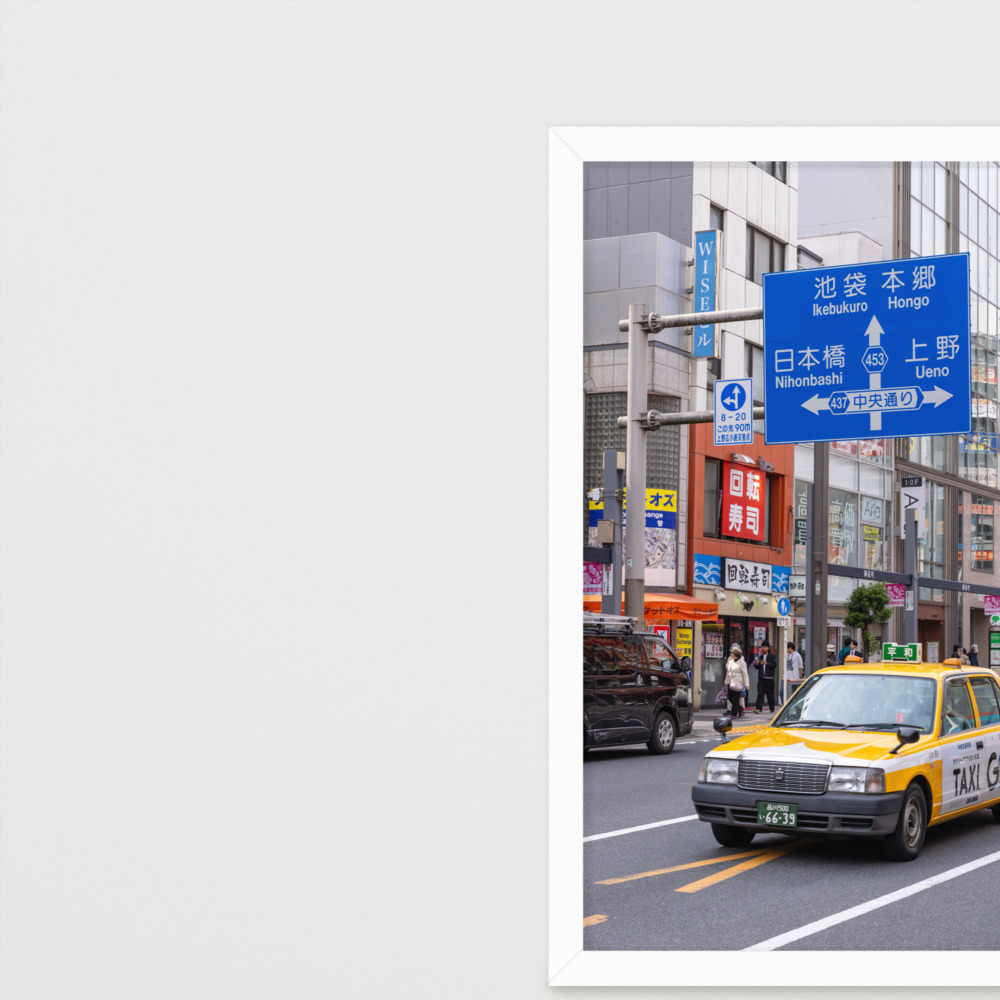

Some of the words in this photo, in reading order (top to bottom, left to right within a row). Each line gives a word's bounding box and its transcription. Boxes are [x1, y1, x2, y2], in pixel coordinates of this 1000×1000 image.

[698, 240, 714, 348] WISEル
[814, 272, 867, 300] 池袋
[881, 264, 936, 293] 本郷
[812, 301, 868, 317] Ikebukuro
[887, 295, 930, 311] Hongo
[774, 344, 846, 372] 日本橋
[864, 353, 885, 367] 453
[904, 334, 960, 363] 上野
[775, 372, 843, 389] Nihonbashi
[915, 365, 950, 379] Ueno
[830, 395, 848, 410] 437
[853, 390, 914, 410] 中央通り
[730, 469, 760, 502] 回転
[728, 503, 759, 536] 寿司
[727, 563, 771, 588] 回転寿司
[952, 763, 980, 797] TAXI
